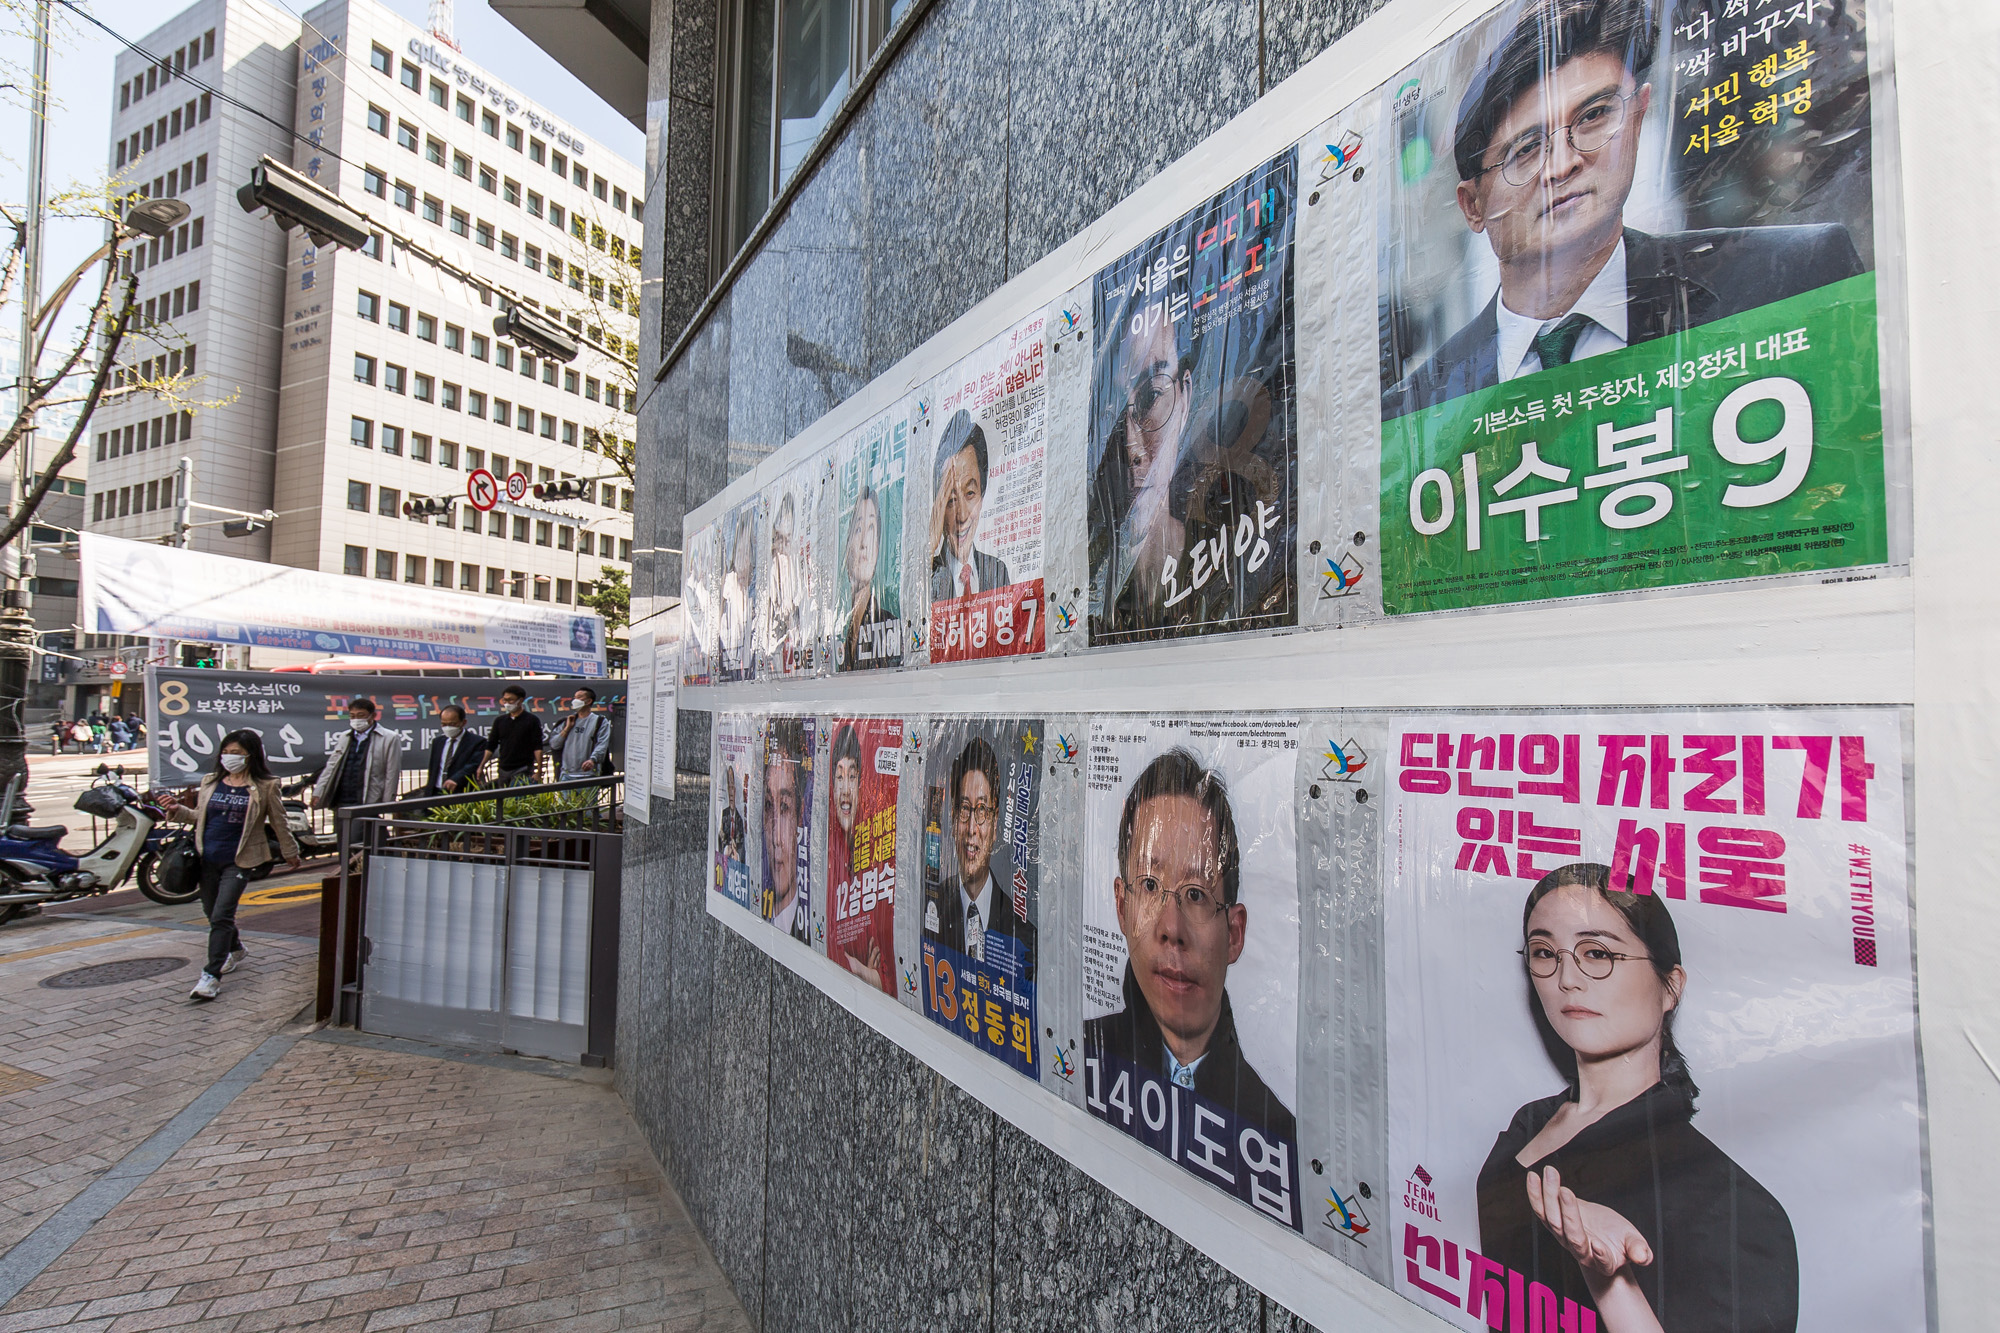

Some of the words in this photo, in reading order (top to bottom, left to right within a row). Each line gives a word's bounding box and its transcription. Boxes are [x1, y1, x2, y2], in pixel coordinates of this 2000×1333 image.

[1721, 1, 1821, 57] 바꾸자
[302, 34, 341, 74] cpbc
[409, 38, 450, 74] cpbc
[1684, 72, 1741, 118] 서민
[1747, 40, 1816, 88] 행복
[1393, 87, 1421, 113] 민생당
[1684, 114, 1745, 155] 서울
[1749, 79, 1812, 125] 혁명
[1131, 244, 1191, 297] 서울은
[1196, 187, 1275, 262] 무지개
[1131, 292, 1190, 337] 이기는
[1192, 236, 1275, 310] 소수자
[1243, 290, 1269, 309] 서울시장
[1244, 278, 1270, 297] 서울시장
[1014, 338, 1044, 367] 아니라
[1005, 359, 1045, 395] 많습니다
[1472, 402, 1546, 436] 기본소득
[1551, 392, 1573, 419] 첫
[1578, 372, 1650, 411] 주창자,
[1655, 342, 1747, 390] 제3정치
[1755, 327, 1811, 361] 대표
[981, 407, 994, 421] 국가
[1017, 384, 1045, 406] 내다보는
[995, 407, 1022, 430] 허경영이
[989, 461, 1006, 479] 서울시
[1409, 406, 1690, 552] 이수봉
[1712, 376, 1815, 509] 9
[510, 478, 523, 493] 50
[1804, 538, 1845, 552] 위원장(현)
[1822, 522, 1854, 535] 원장(전)
[1161, 500, 1281, 608] 오태양
[949, 602, 1015, 650] 허경영
[1021, 599, 1039, 645] 7
[1260, 740, 1280, 748] 생각의
[1283, 740, 1299, 748] 창문)
[877, 759, 897, 772] 지지후보
[1399, 732, 1581, 804] 당신의
[1016, 761, 1033, 815] 서울
[854, 817, 872, 848] 강남
[872, 804, 896, 838] 해체!
[1013, 816, 1029, 872] 경제
[853, 843, 871, 873] 평등
[872, 831, 896, 865] 서울!
[1454, 806, 1582, 881] 있는
[1606, 818, 1788, 915] 서울
[762, 888, 774, 919] 11
[835, 880, 848, 923] 12
[848, 862, 896, 918] 송명숙
[1848, 843, 1876, 938] #WITHYOU
[1105, 953, 1119, 964] 대학원
[1105, 963, 1114, 973] 수료
[924, 952, 959, 1021] 13
[1104, 1001, 1115, 1011] 작가
[961, 987, 1033, 1065] 정동희
[1086, 1058, 1134, 1126] 14
[1140, 1079, 1294, 1227] 이도엽
[1403, 1193, 1442, 1223] SEOUL
[1405, 1179, 1436, 1205] TEAM
